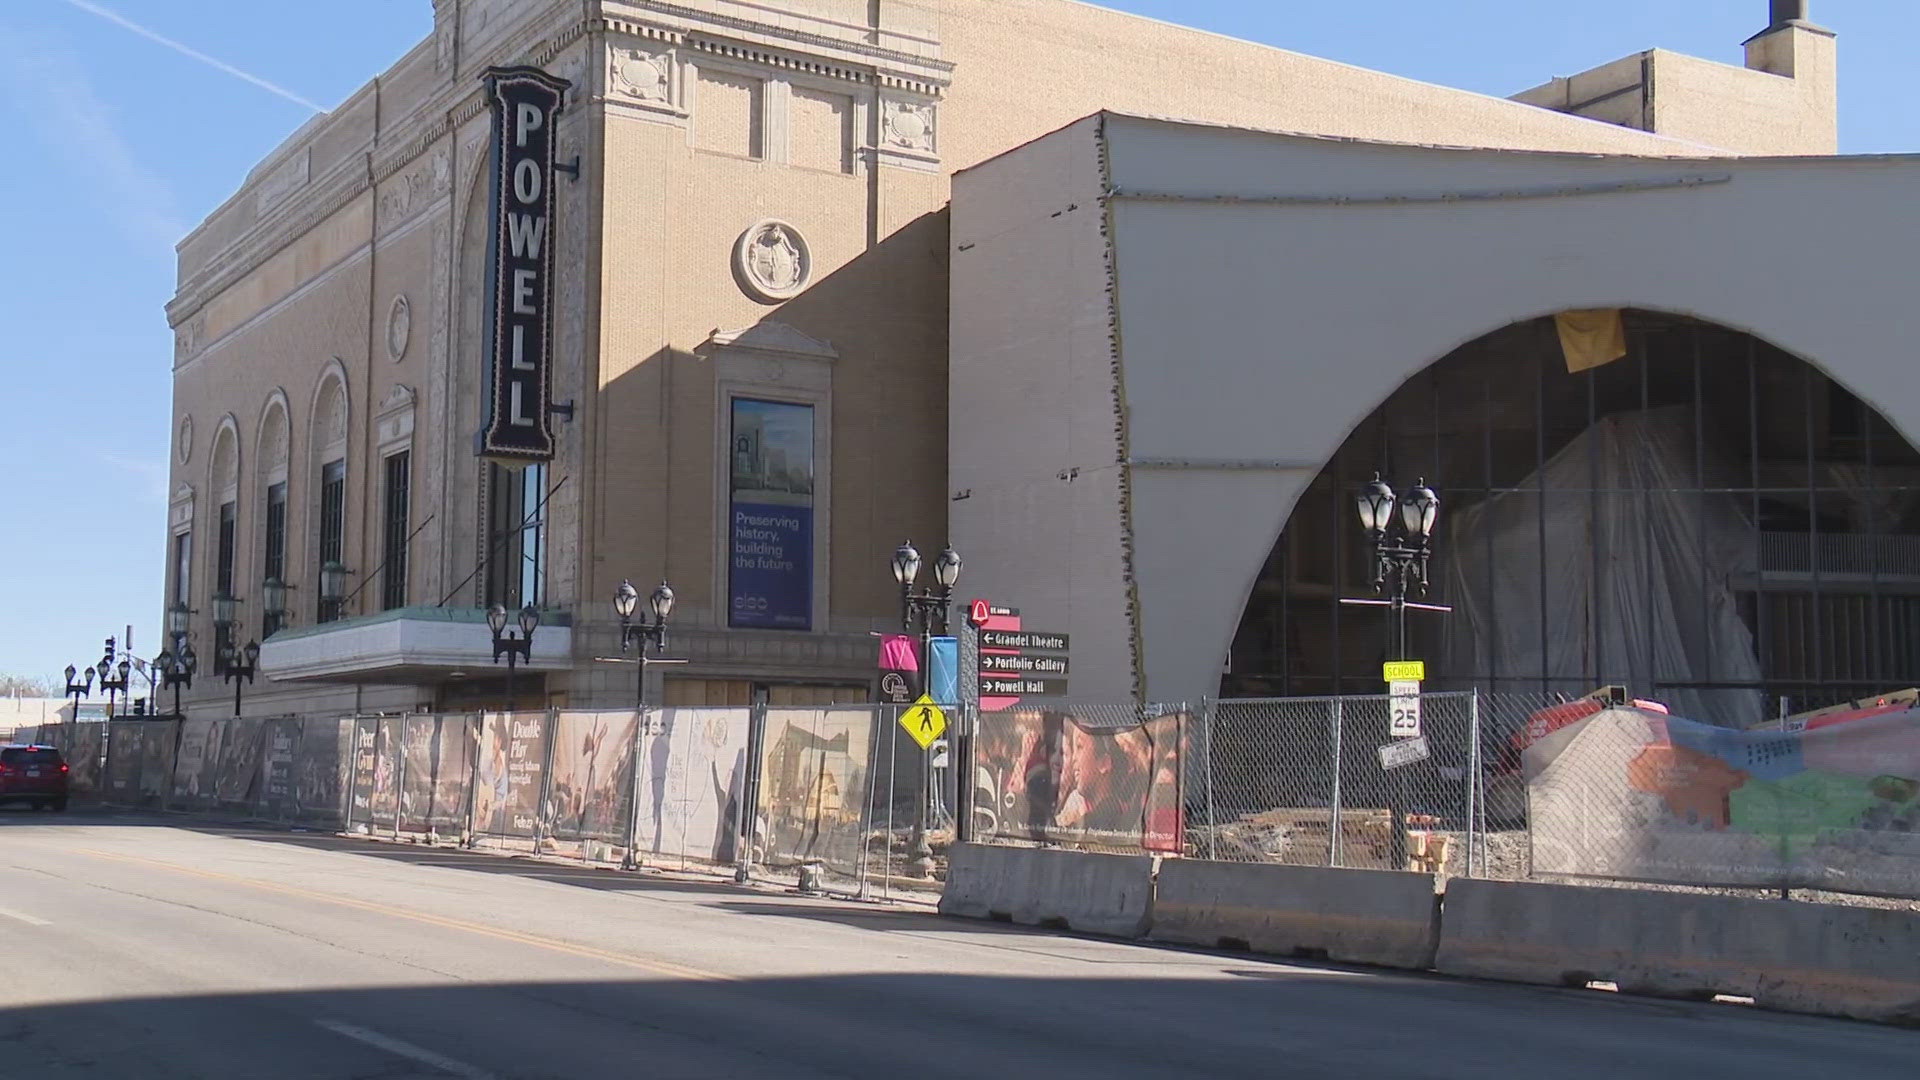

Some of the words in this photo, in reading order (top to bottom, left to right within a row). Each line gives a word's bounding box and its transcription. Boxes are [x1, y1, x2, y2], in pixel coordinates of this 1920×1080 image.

[508, 102, 545, 427] POWELL
[736, 512, 800, 531] Preserving
[736, 527, 780, 543] history,
[736, 542, 783, 558] building
[736, 557, 754, 568] the
[757, 557, 794, 570] future
[995, 633, 1029, 646] Grandel
[1032, 635, 1064, 648] Theatre
[995, 657, 1033, 670] Portfolio
[1035, 659, 1066, 674] Gallery
[1387, 665, 1421, 678] SCHOOL
[995, 681, 1024, 692] Powell
[1026, 681, 1044, 693] Hall
[1394, 709, 1417, 728] 25
[513, 719, 541, 738] Double
[359, 727, 375, 748] Peer
[510, 740, 529, 763] Play
